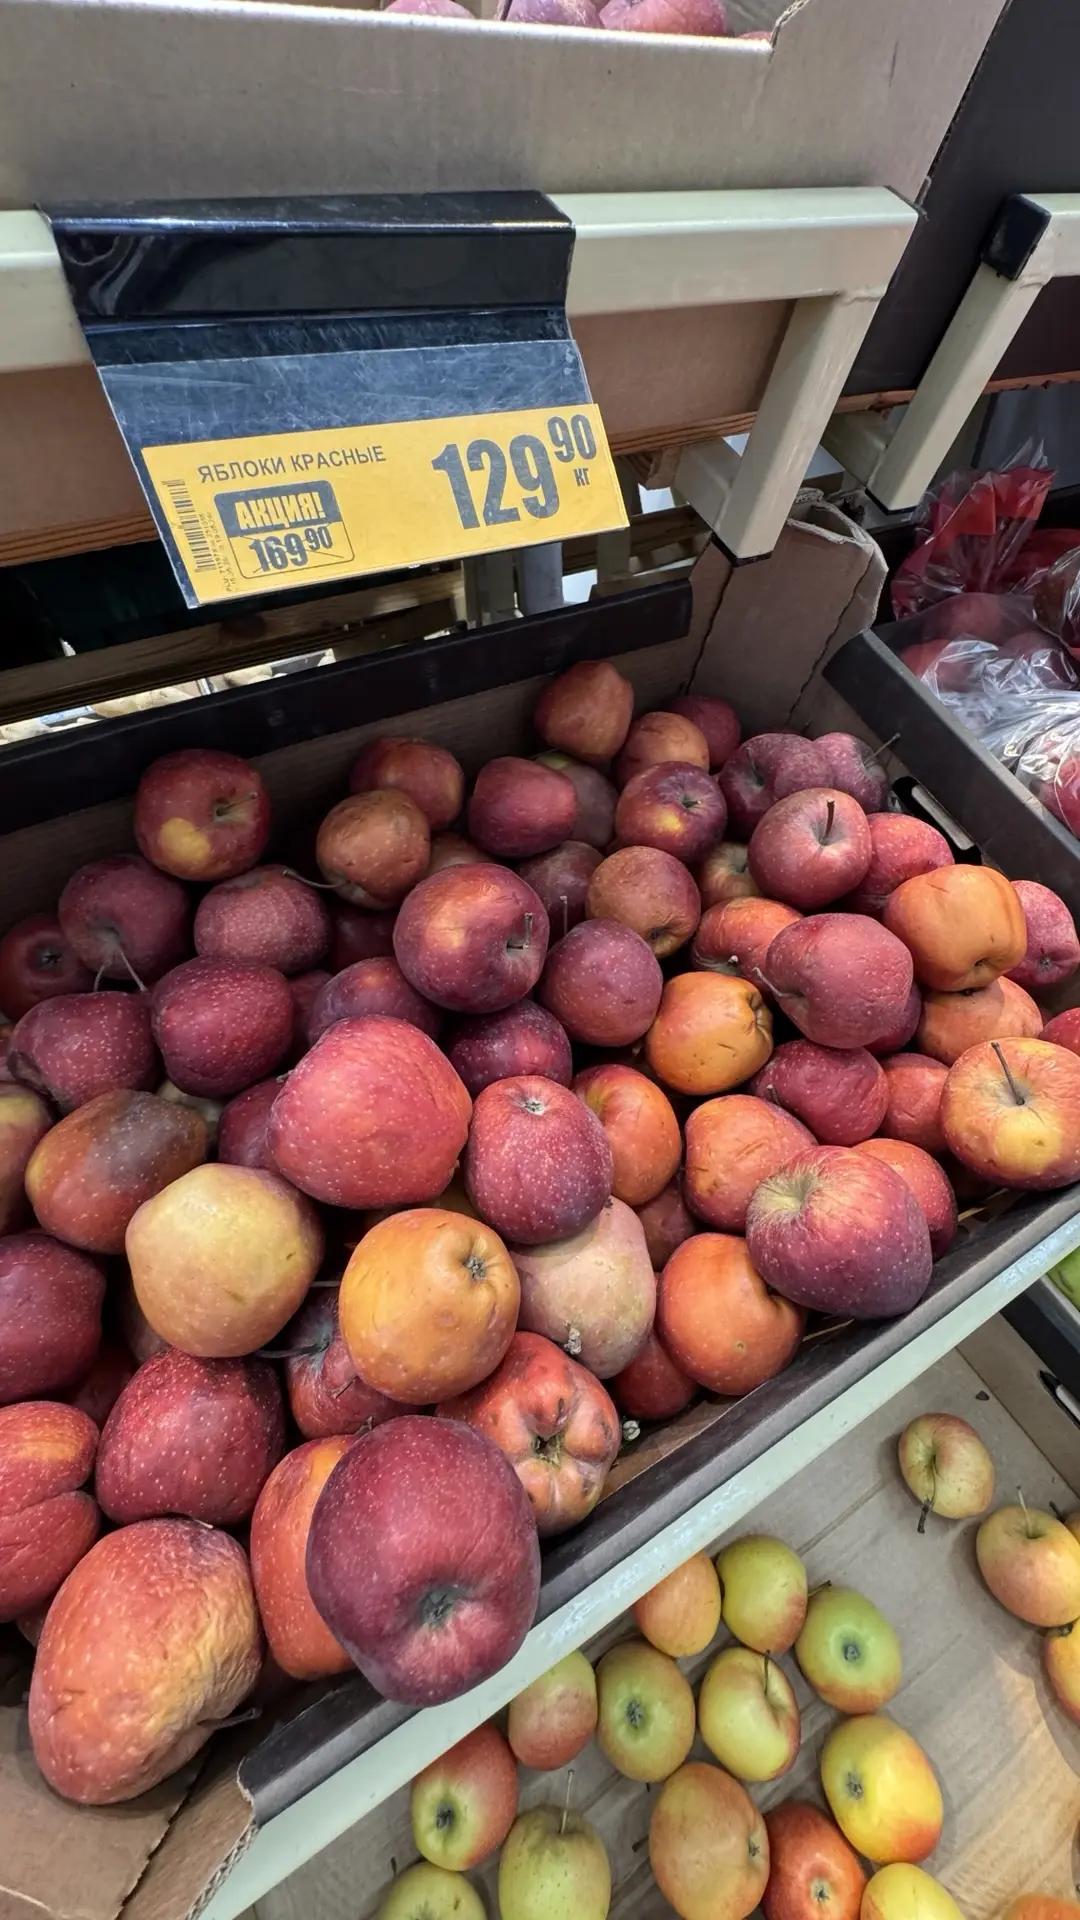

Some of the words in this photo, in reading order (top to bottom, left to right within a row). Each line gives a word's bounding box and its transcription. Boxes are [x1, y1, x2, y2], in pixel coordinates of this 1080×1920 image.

[197, 457, 286, 483] ЯБЛОКИ
[290, 445, 386, 471] КРАСНЫЕ
[431, 434, 560, 529] 129
[547, 414, 597, 463] 90
[235, 491, 326, 530] АКЦИЯ!
[248, 533, 308, 572] 169
[304, 525, 333, 550] 90
